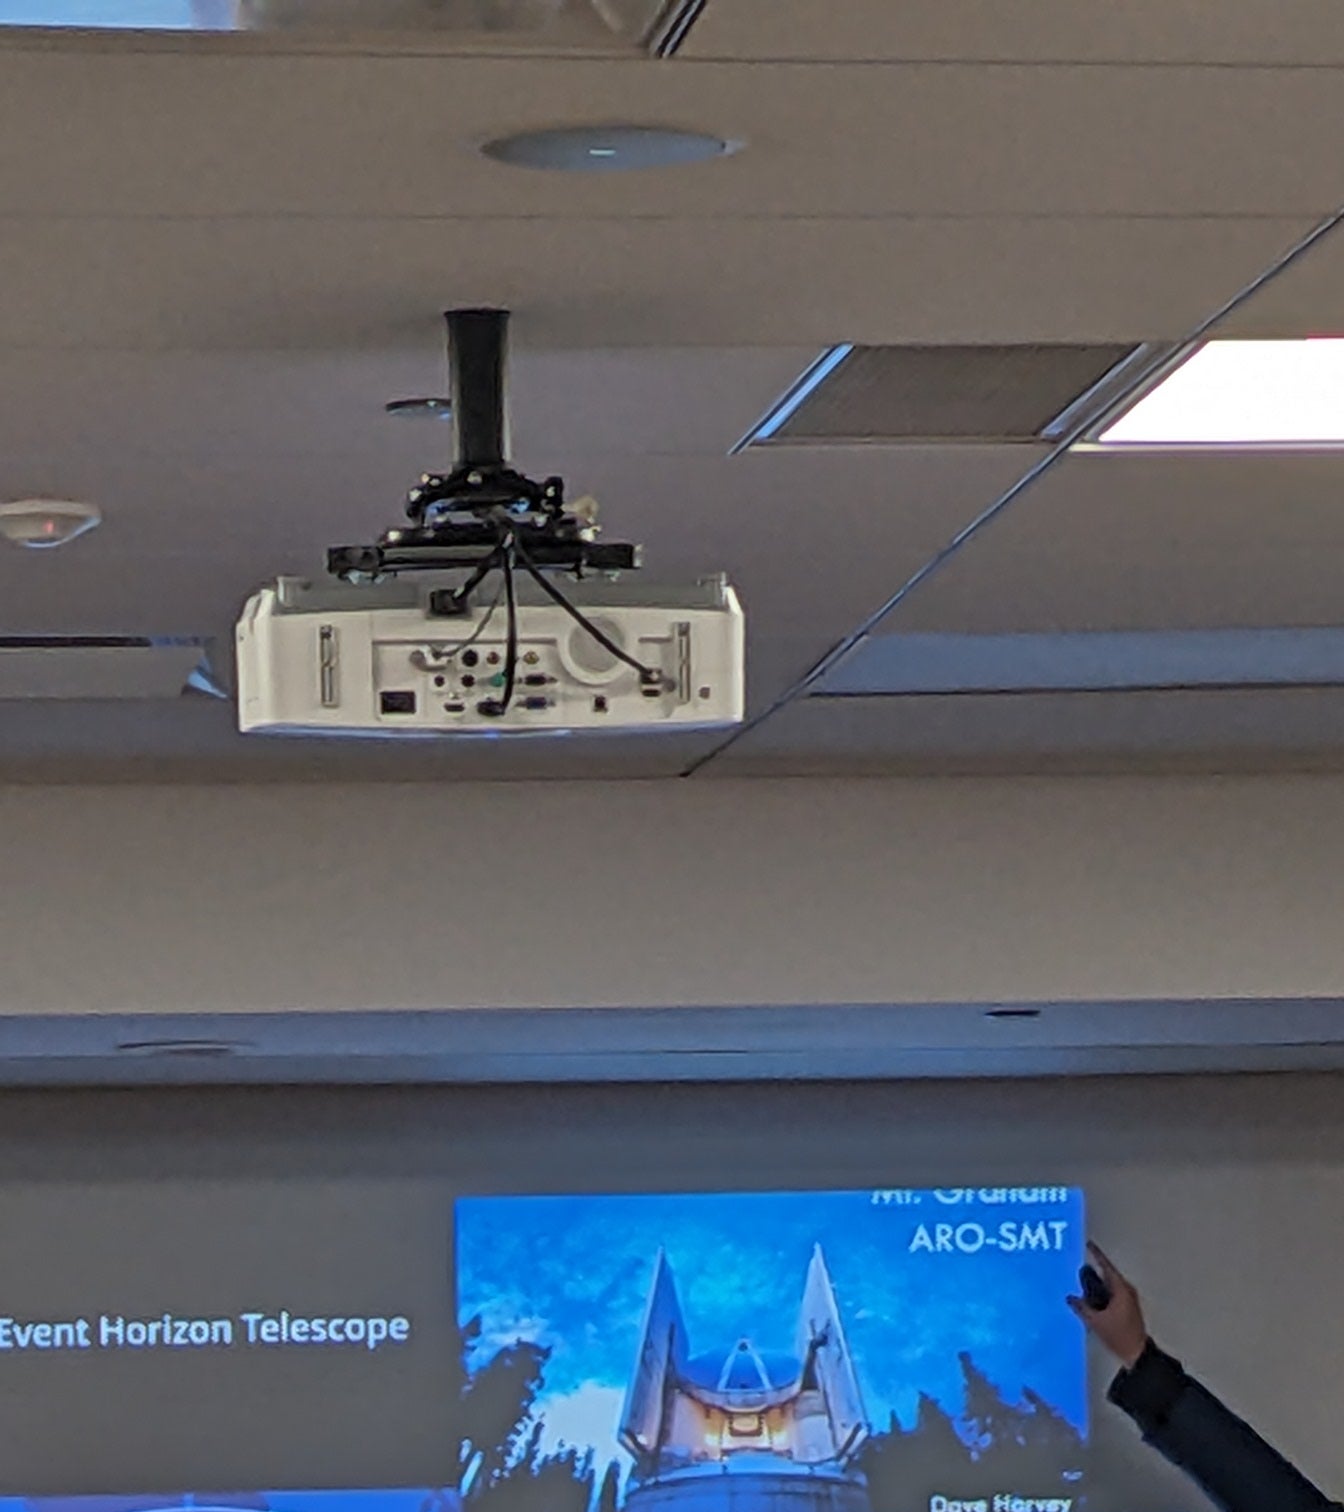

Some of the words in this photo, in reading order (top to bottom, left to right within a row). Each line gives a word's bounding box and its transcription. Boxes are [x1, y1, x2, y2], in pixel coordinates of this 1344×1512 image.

[908, 1221, 1068, 1254] ARO-SMT
[99, 1313, 232, 1348] Horizon
[241, 1311, 410, 1350] Telescope
